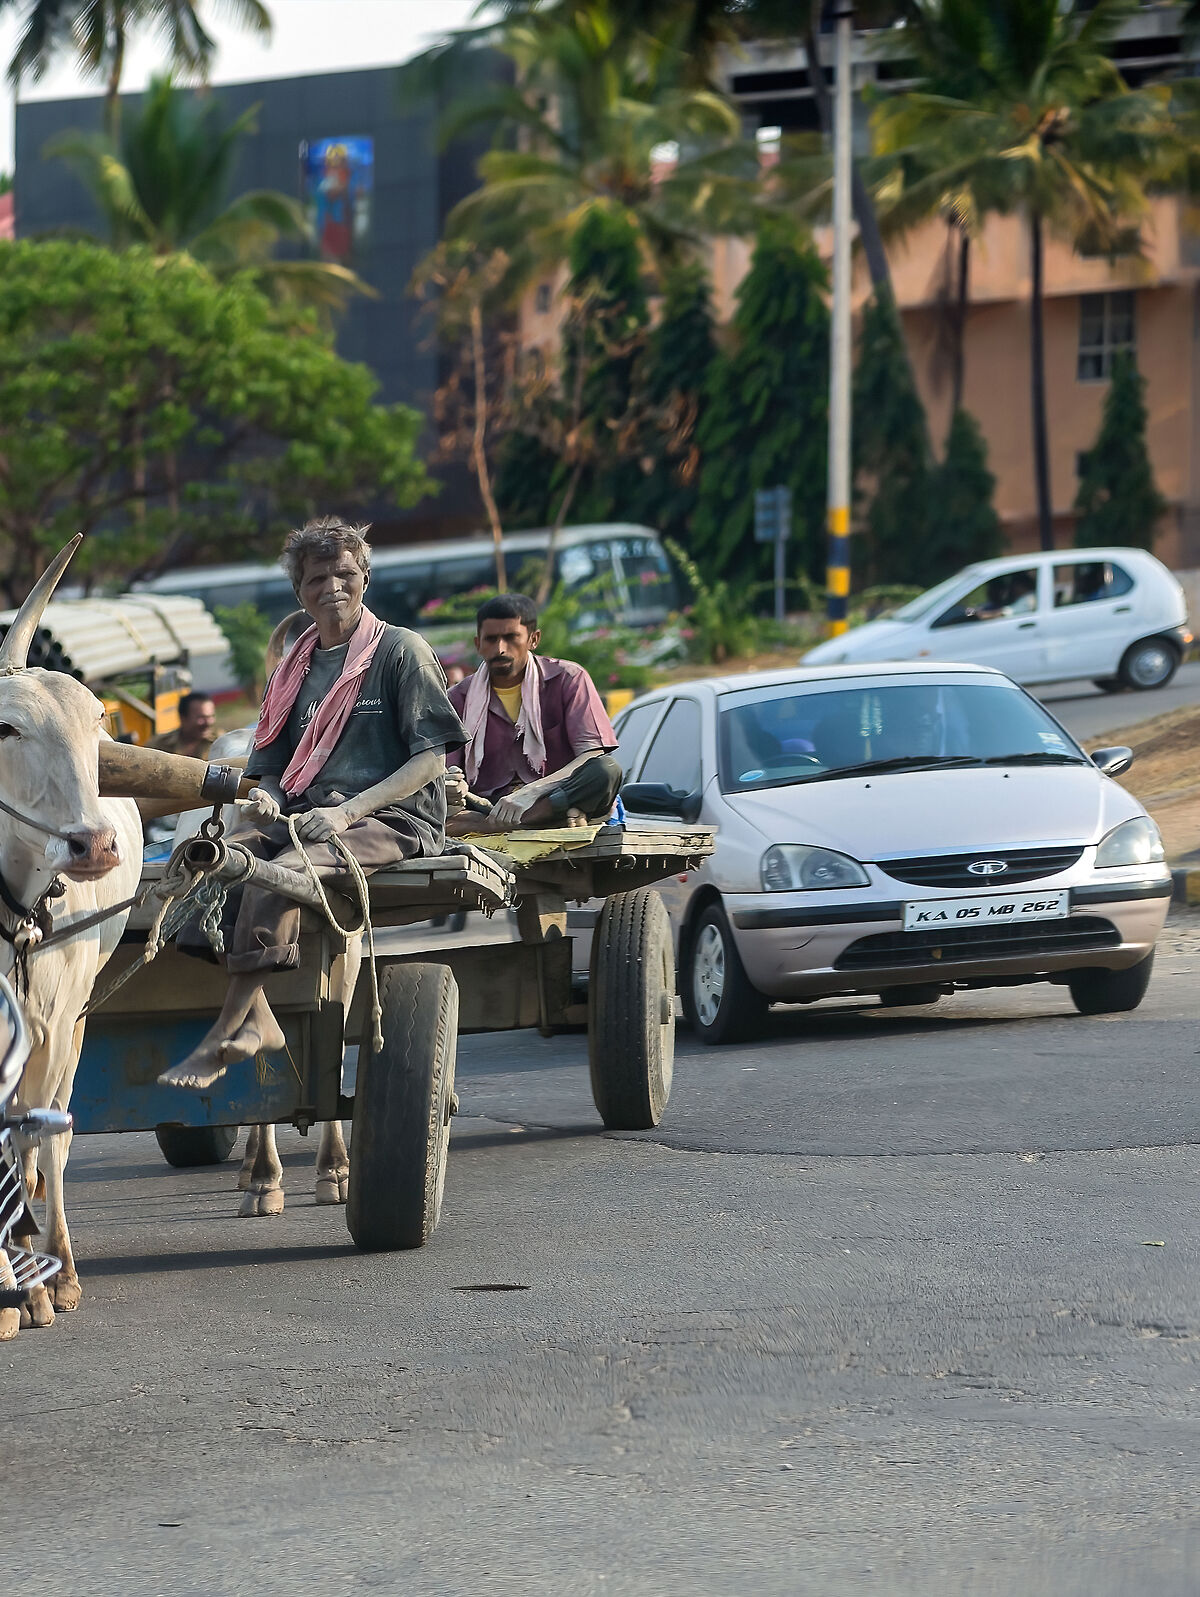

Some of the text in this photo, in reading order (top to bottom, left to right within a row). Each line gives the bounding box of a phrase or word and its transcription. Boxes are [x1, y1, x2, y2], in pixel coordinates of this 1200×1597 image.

[915, 900, 1060, 922] KA 05 MB 262
